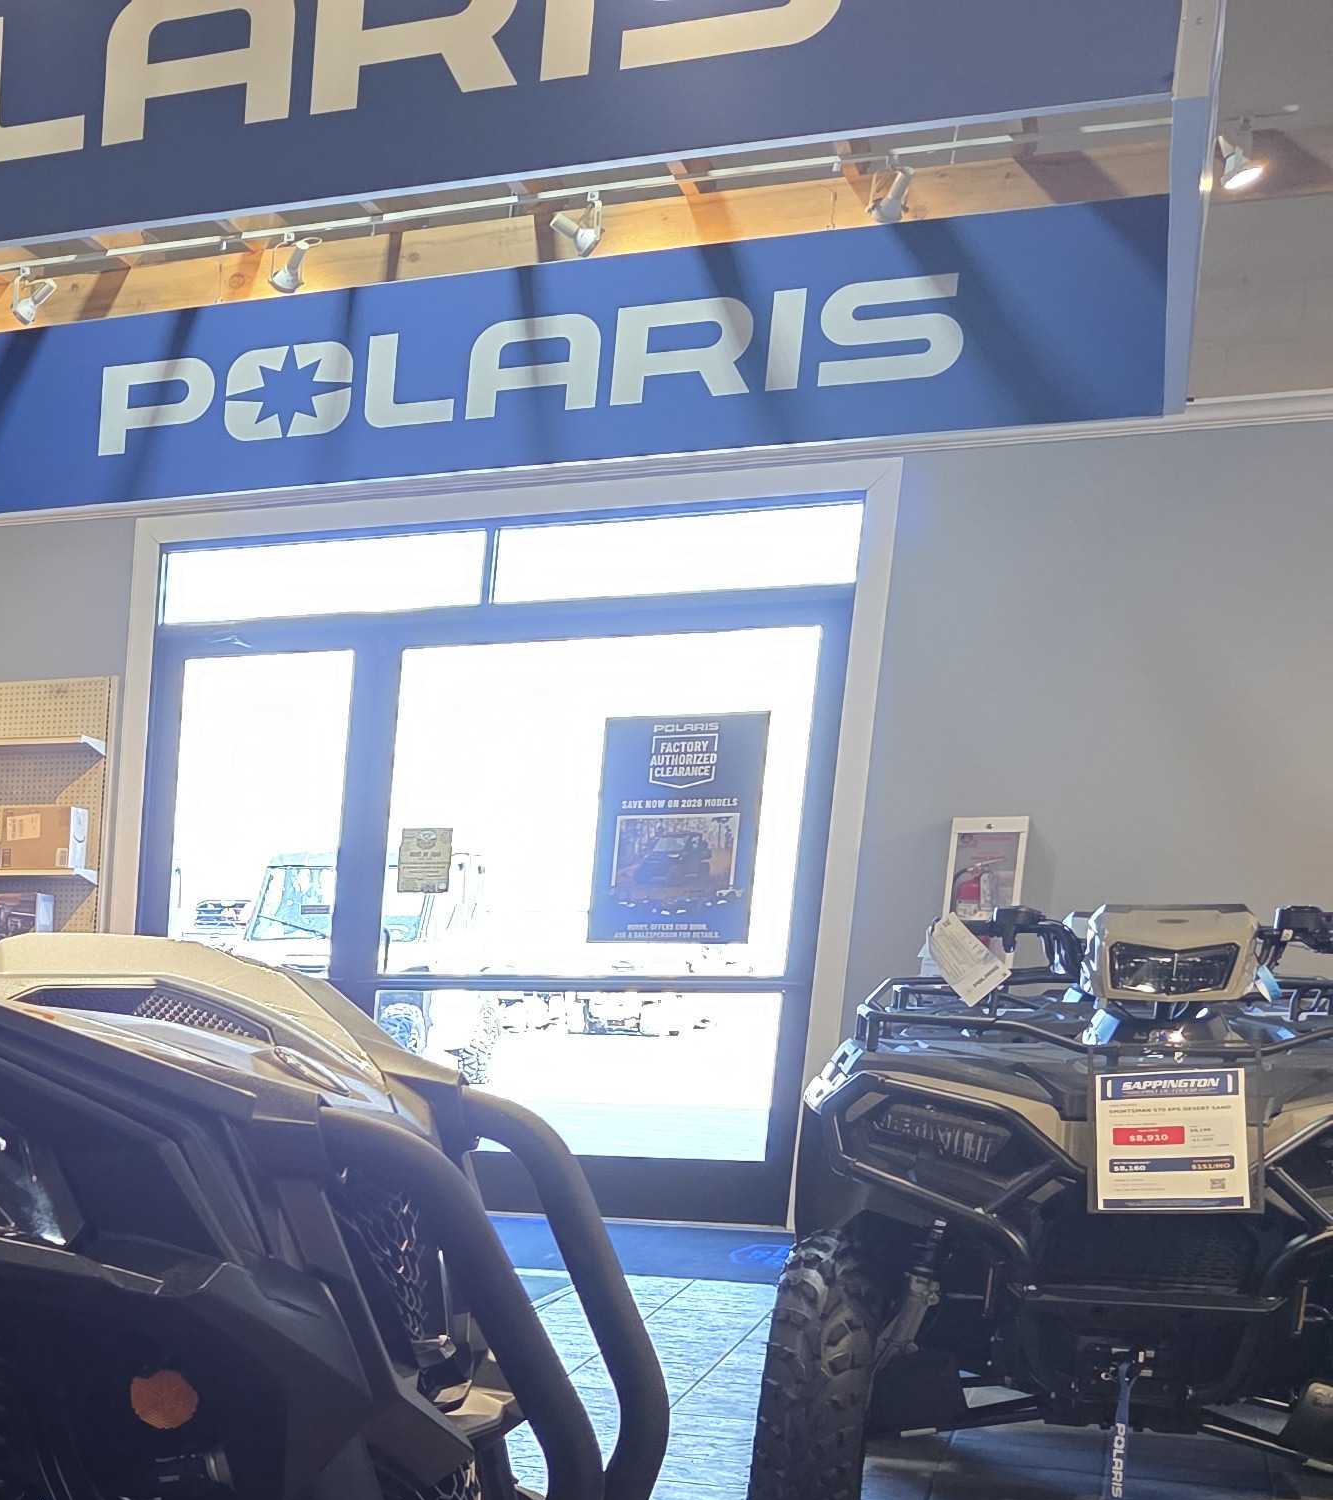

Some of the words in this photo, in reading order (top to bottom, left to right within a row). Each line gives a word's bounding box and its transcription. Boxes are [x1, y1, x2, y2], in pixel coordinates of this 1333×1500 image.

[98, 273, 964, 456] POLARIS
[653, 722, 720, 732] POLARIS
[660, 740, 709, 753] FACTORY
[649, 753, 718, 766] AUTHORIZED
[654, 766, 711, 777] CLEARANCE
[621, 799, 644, 809] SAVE
[704, 798, 739, 807] MODELS
[1121, 1077, 1220, 1091] SAPPINGTON
[1111, 1422, 1126, 1499] POLARIS
